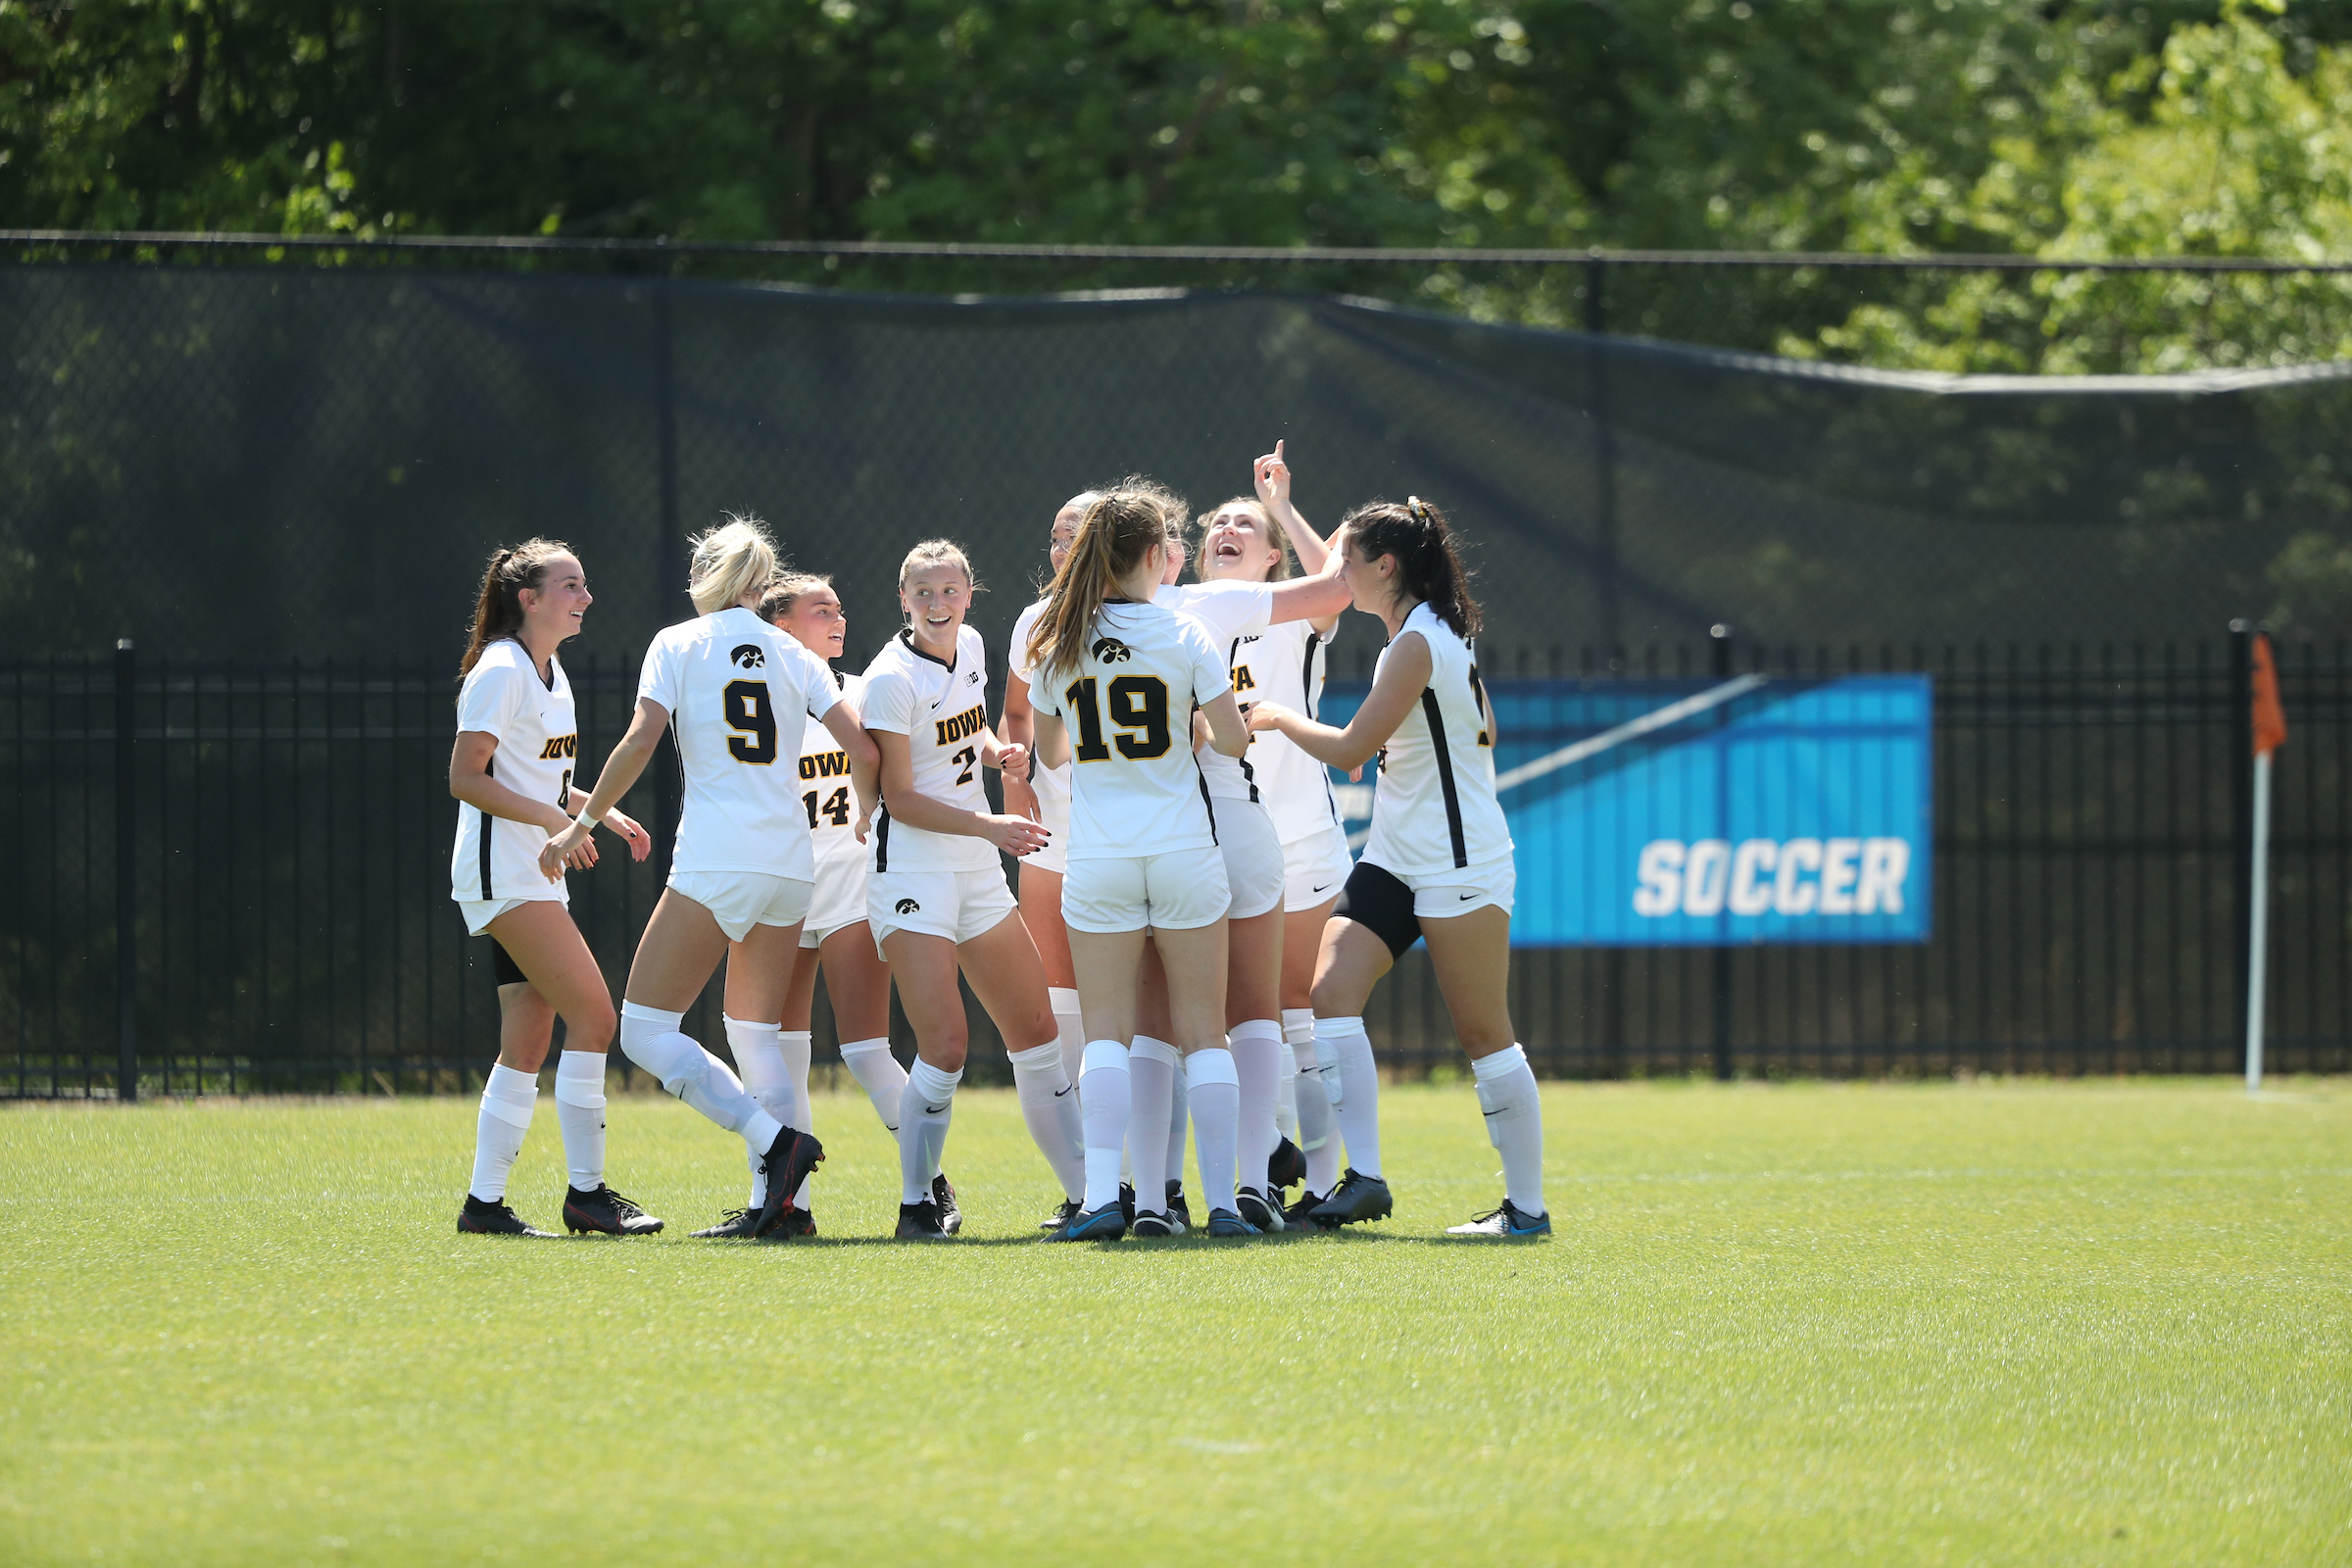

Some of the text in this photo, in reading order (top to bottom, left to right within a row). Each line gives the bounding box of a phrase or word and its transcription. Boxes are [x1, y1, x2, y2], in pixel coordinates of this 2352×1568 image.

[721, 678, 778, 766] 9
[936, 703, 987, 747] IOWA
[1064, 674, 1173, 764] 19
[539, 733, 577, 760] IOW
[798, 750, 852, 781] OW
[952, 745, 977, 787] 2
[802, 786, 850, 830] 14
[1632, 837, 1910, 916] SOCCER
